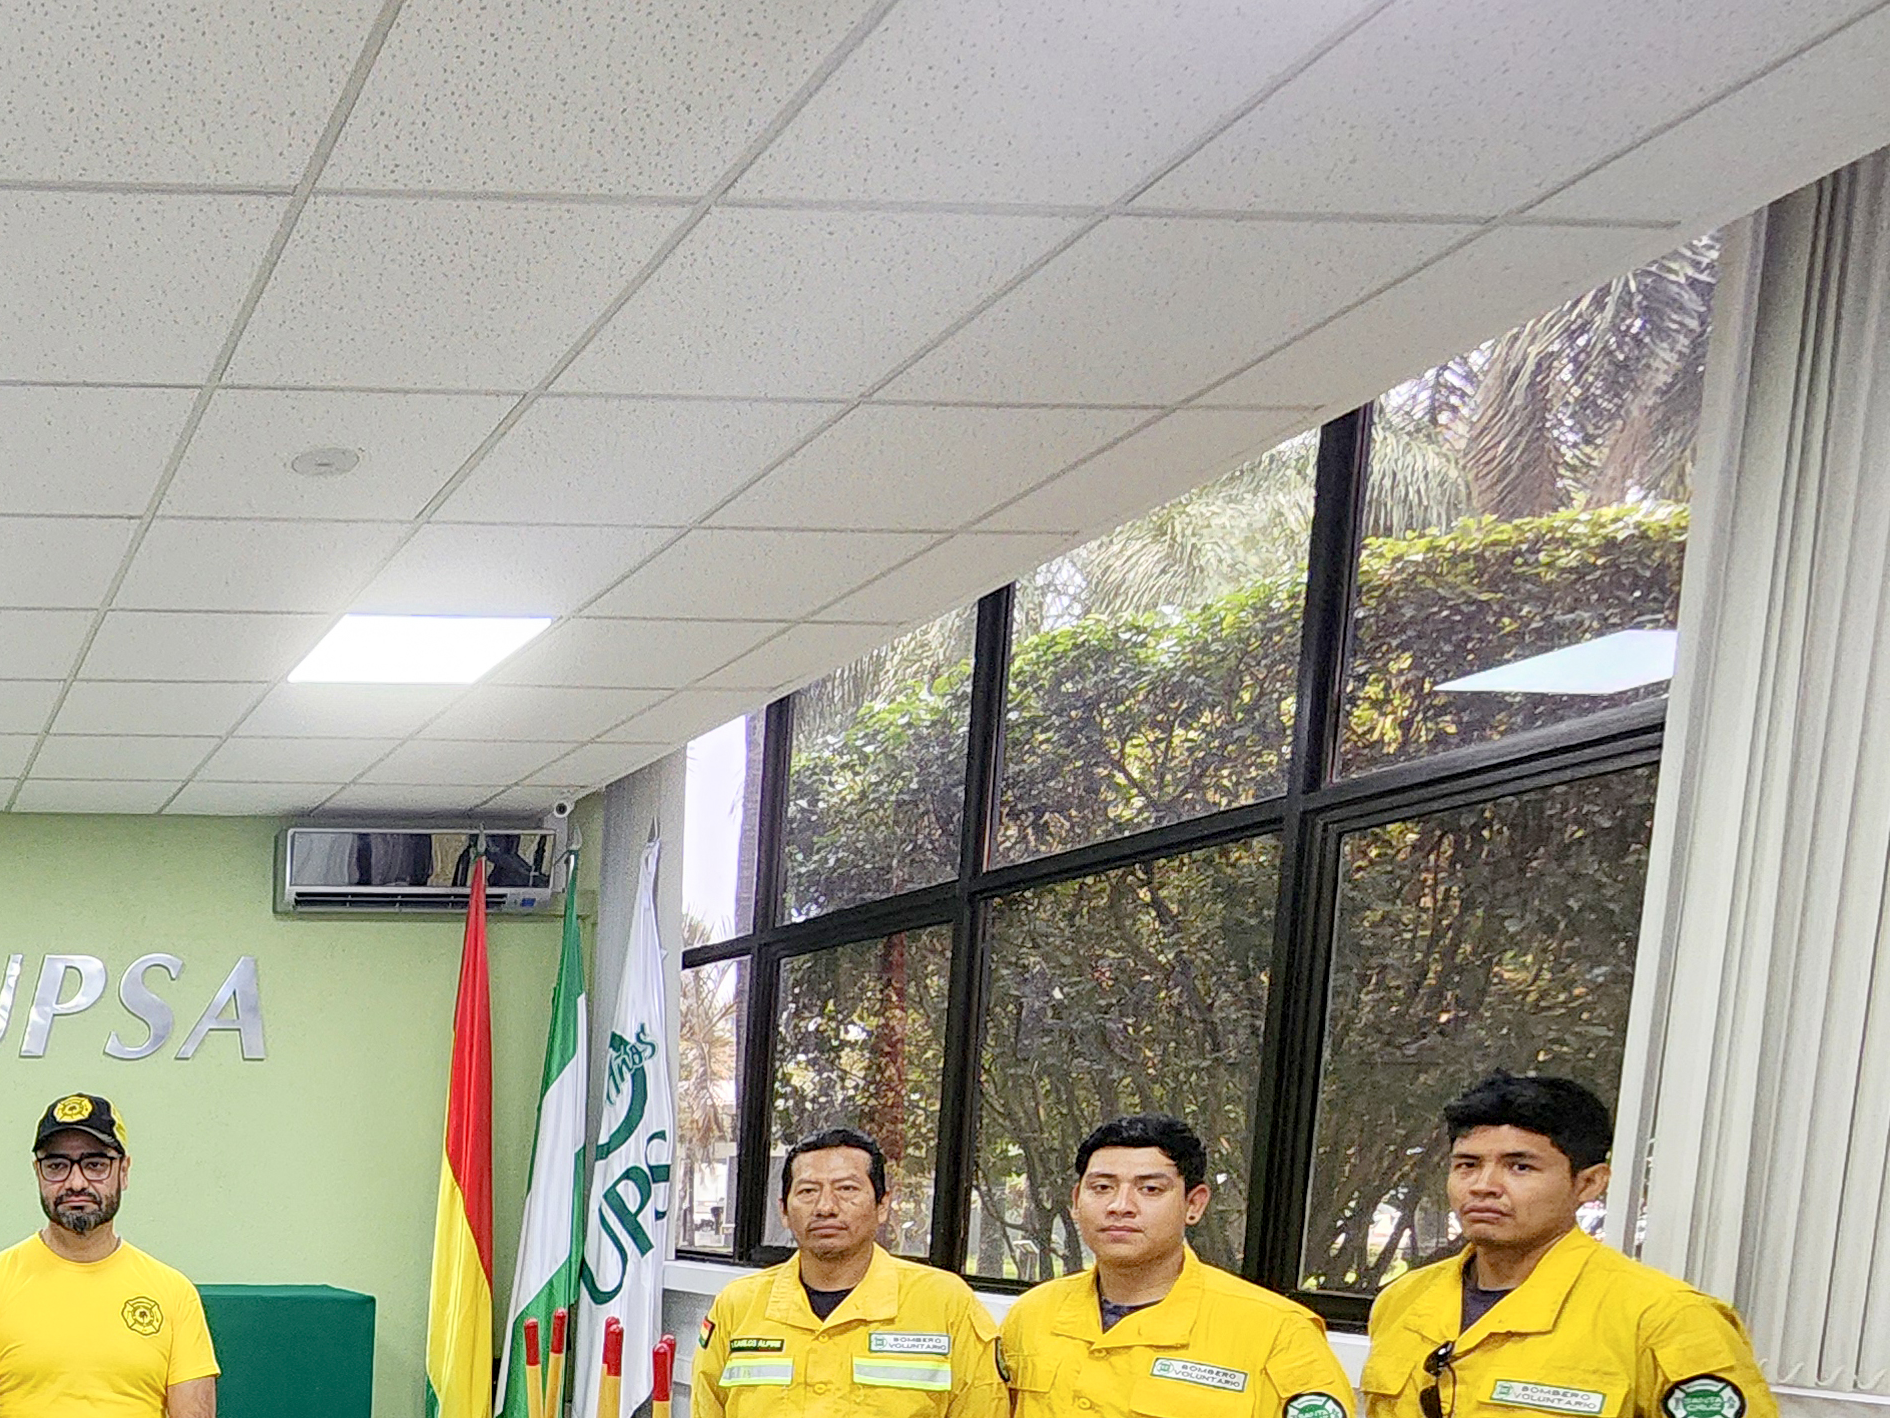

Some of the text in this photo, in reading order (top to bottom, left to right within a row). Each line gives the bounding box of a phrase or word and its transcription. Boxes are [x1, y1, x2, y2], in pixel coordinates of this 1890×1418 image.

[1175, 1370, 1240, 1388] VOLUNTARIO
[1181, 1364, 1236, 1380] BOMBERO
[1514, 1392, 1596, 1409] VOLUNTARIO
[1522, 1386, 1590, 1400] BOMBERO
